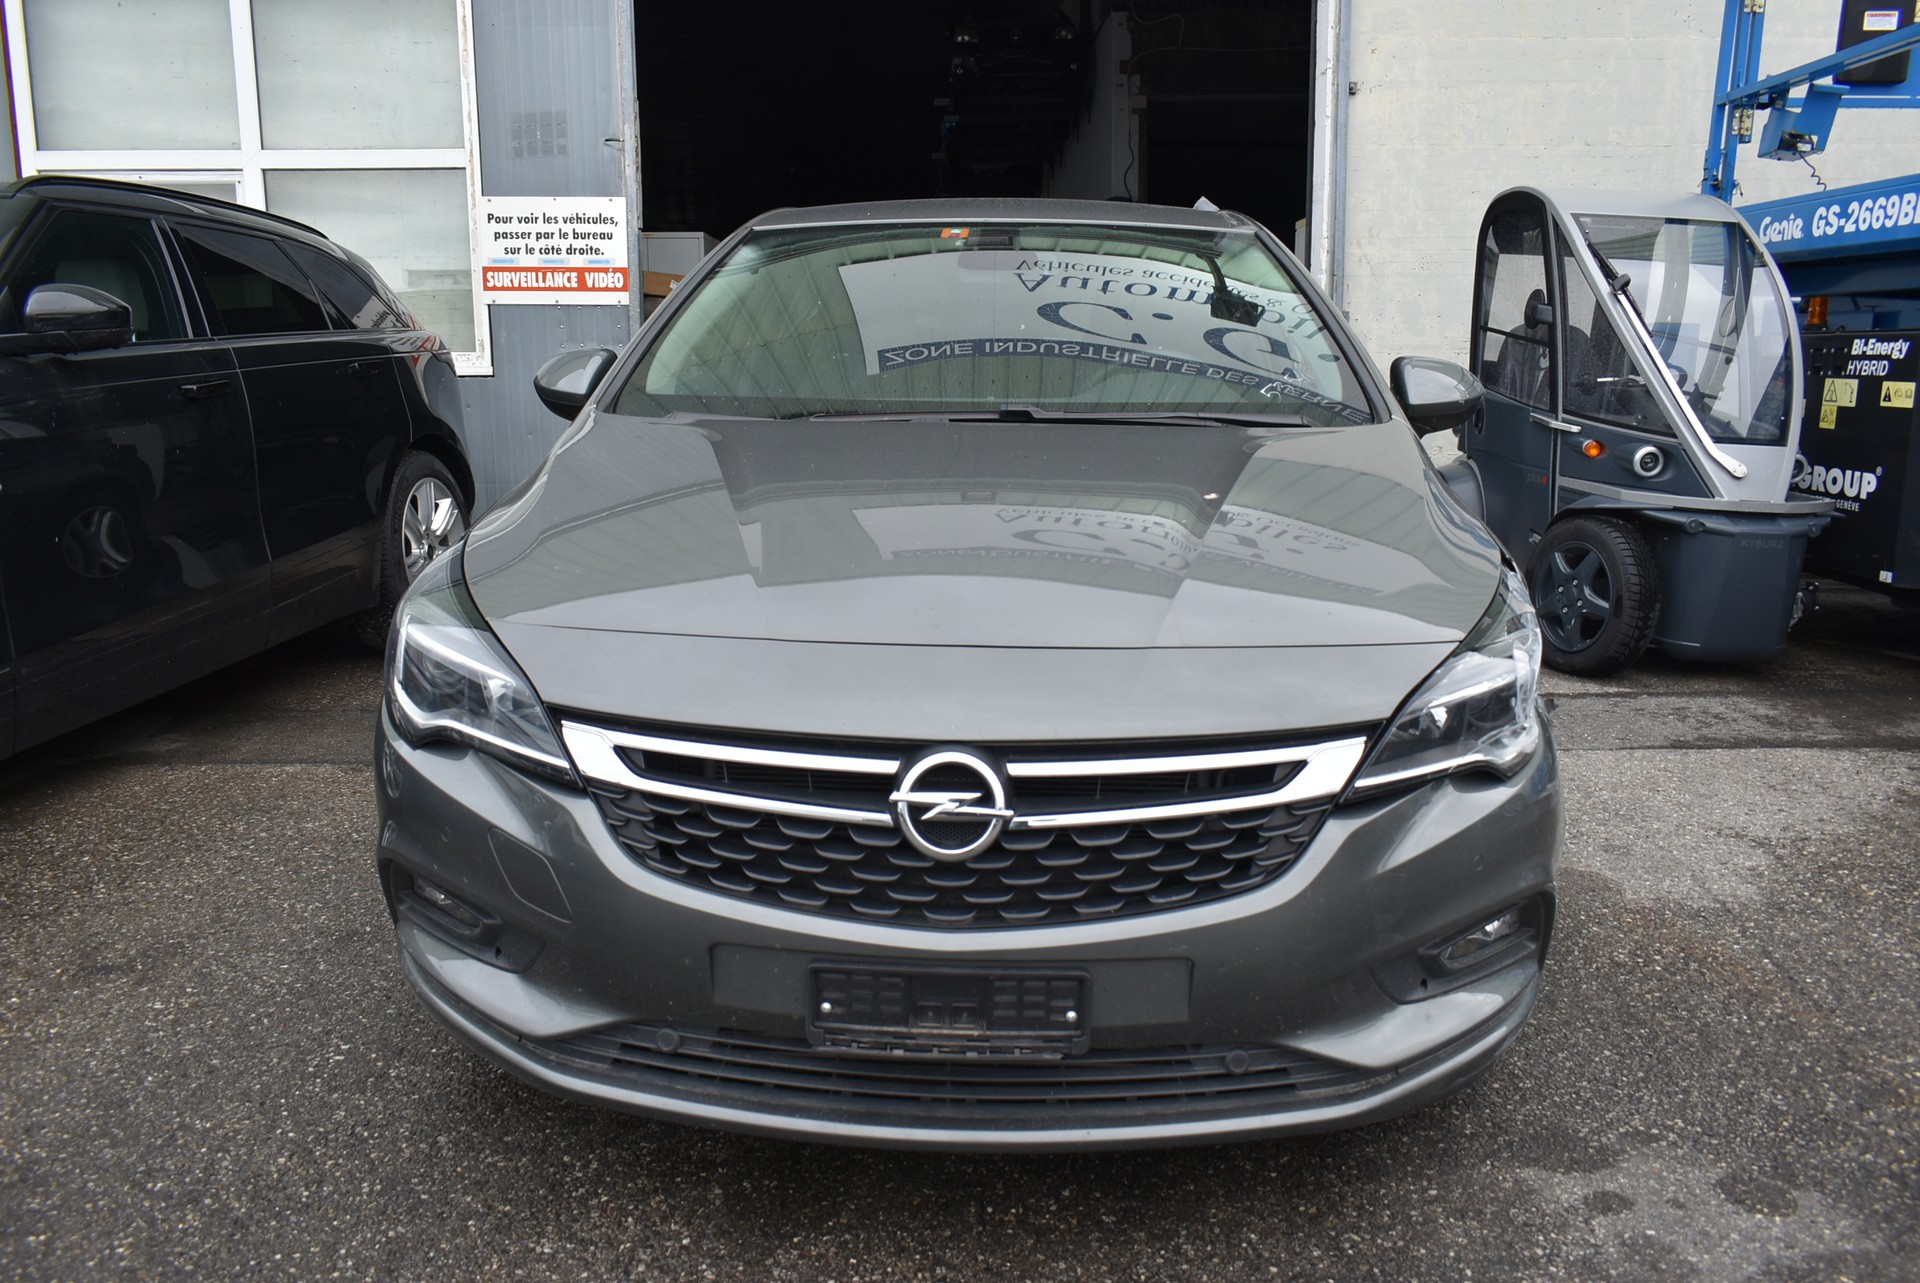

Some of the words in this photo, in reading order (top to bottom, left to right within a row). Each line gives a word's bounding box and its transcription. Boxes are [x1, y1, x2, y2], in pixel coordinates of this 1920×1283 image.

[487, 213, 514, 224] Pour
[517, 212, 539, 224] voir
[543, 212, 559, 224] les
[562, 212, 618, 227] véhicules,
[494, 231, 532, 242] passer
[535, 231, 555, 242] par
[558, 228, 569, 240] le
[572, 228, 613, 240] bureau
[1759, 212, 1803, 244] Genie
[504, 246, 521, 255] sur
[525, 243, 536, 255] le
[539, 243, 562, 255] côté
[565, 243, 605, 256] droite.
[486, 271, 578, 288] SURVEILLANCE
[584, 268, 624, 288] VIDÉO
[1851, 338, 1910, 360] Bi-Energy
[1846, 360, 1889, 376] HYBRID
